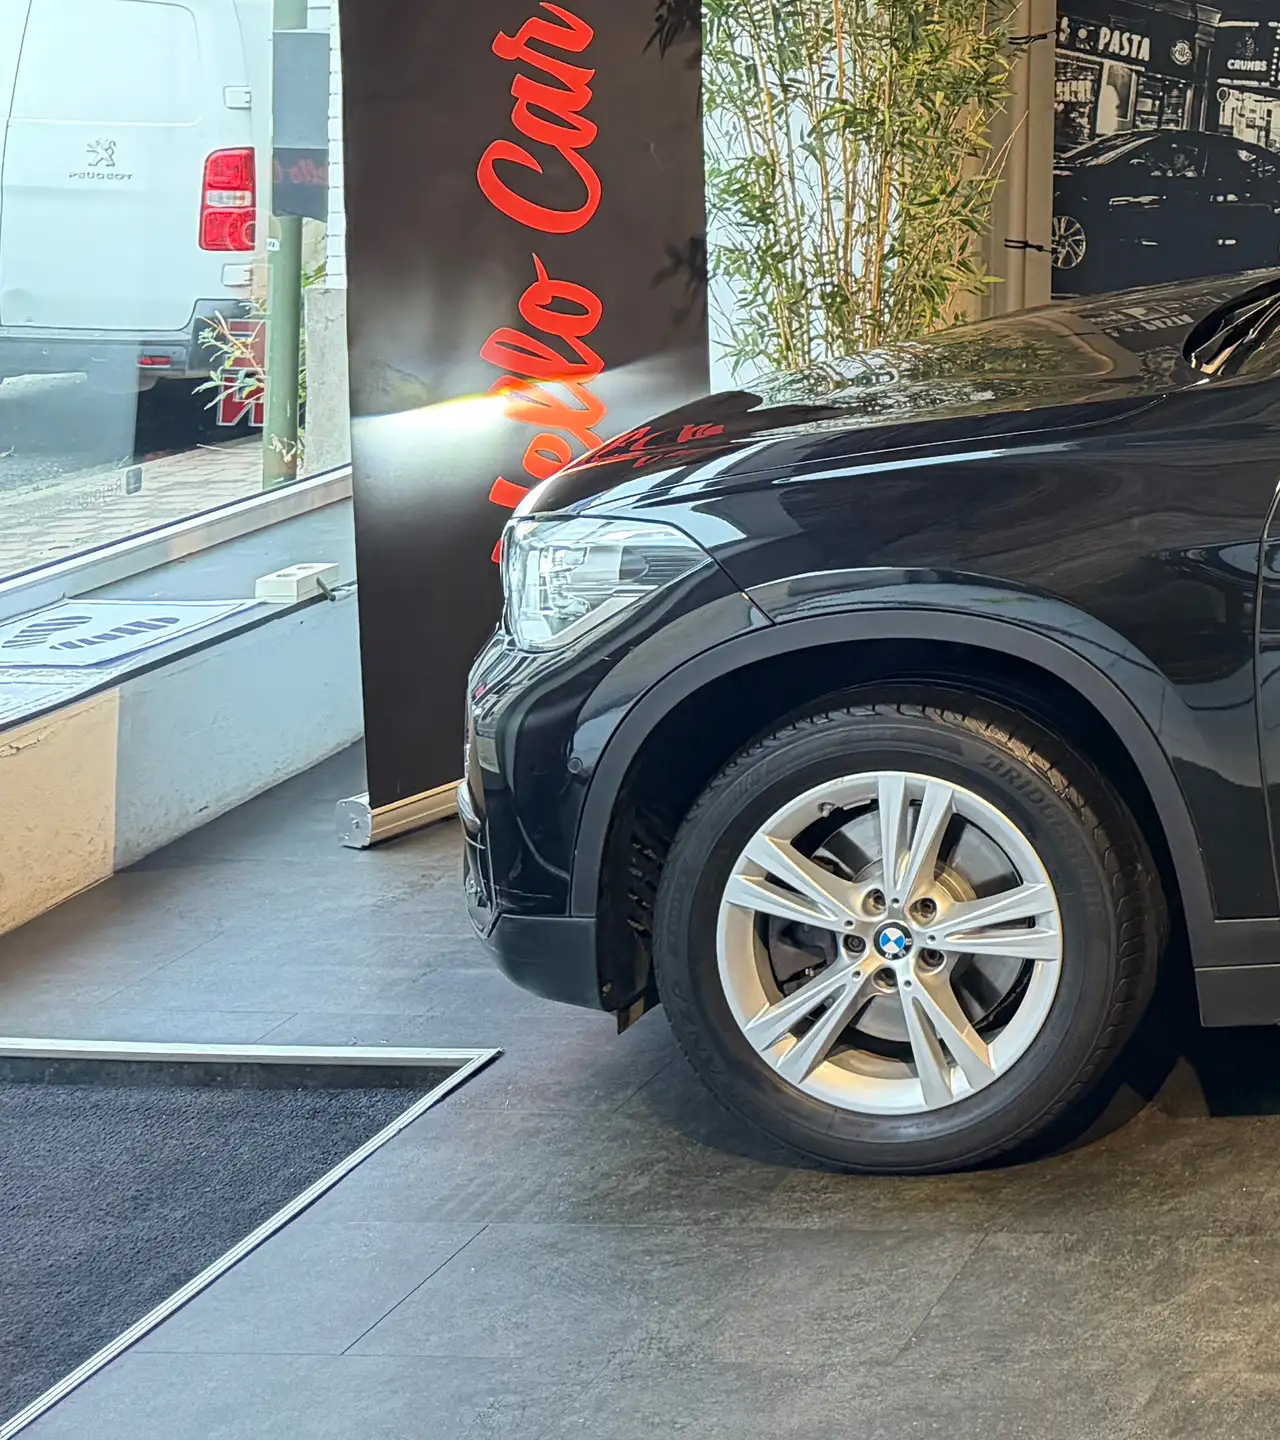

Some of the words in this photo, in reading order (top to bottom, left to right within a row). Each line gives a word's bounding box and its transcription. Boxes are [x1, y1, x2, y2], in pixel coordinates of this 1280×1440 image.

[1099, 27, 1150, 61] PASTA
[1227, 59, 1267, 71] CRUMBS
[477, 1, 602, 233] Car
[479, 252, 608, 509] ello
